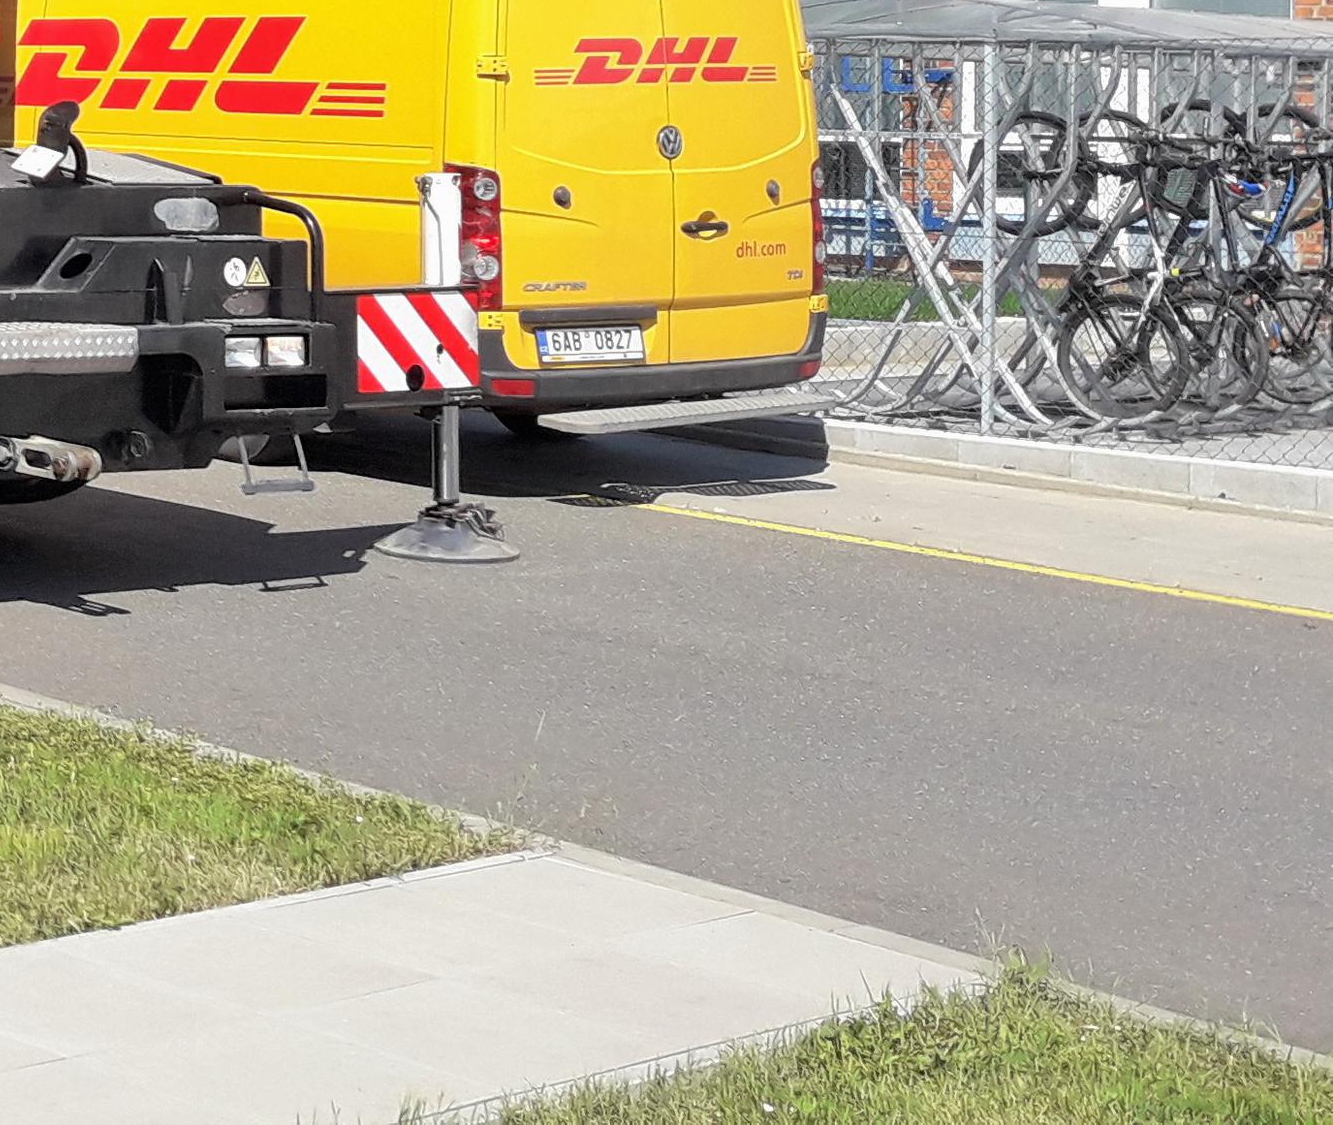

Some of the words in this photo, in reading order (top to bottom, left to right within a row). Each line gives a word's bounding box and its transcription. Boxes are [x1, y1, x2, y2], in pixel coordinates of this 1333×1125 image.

[14, 16, 321, 115] DHL
[572, 37, 749, 85] DHL
[736, 241, 786, 258] dhl.com
[551, 333, 582, 352] 6AB
[594, 330, 632, 350] 0827
